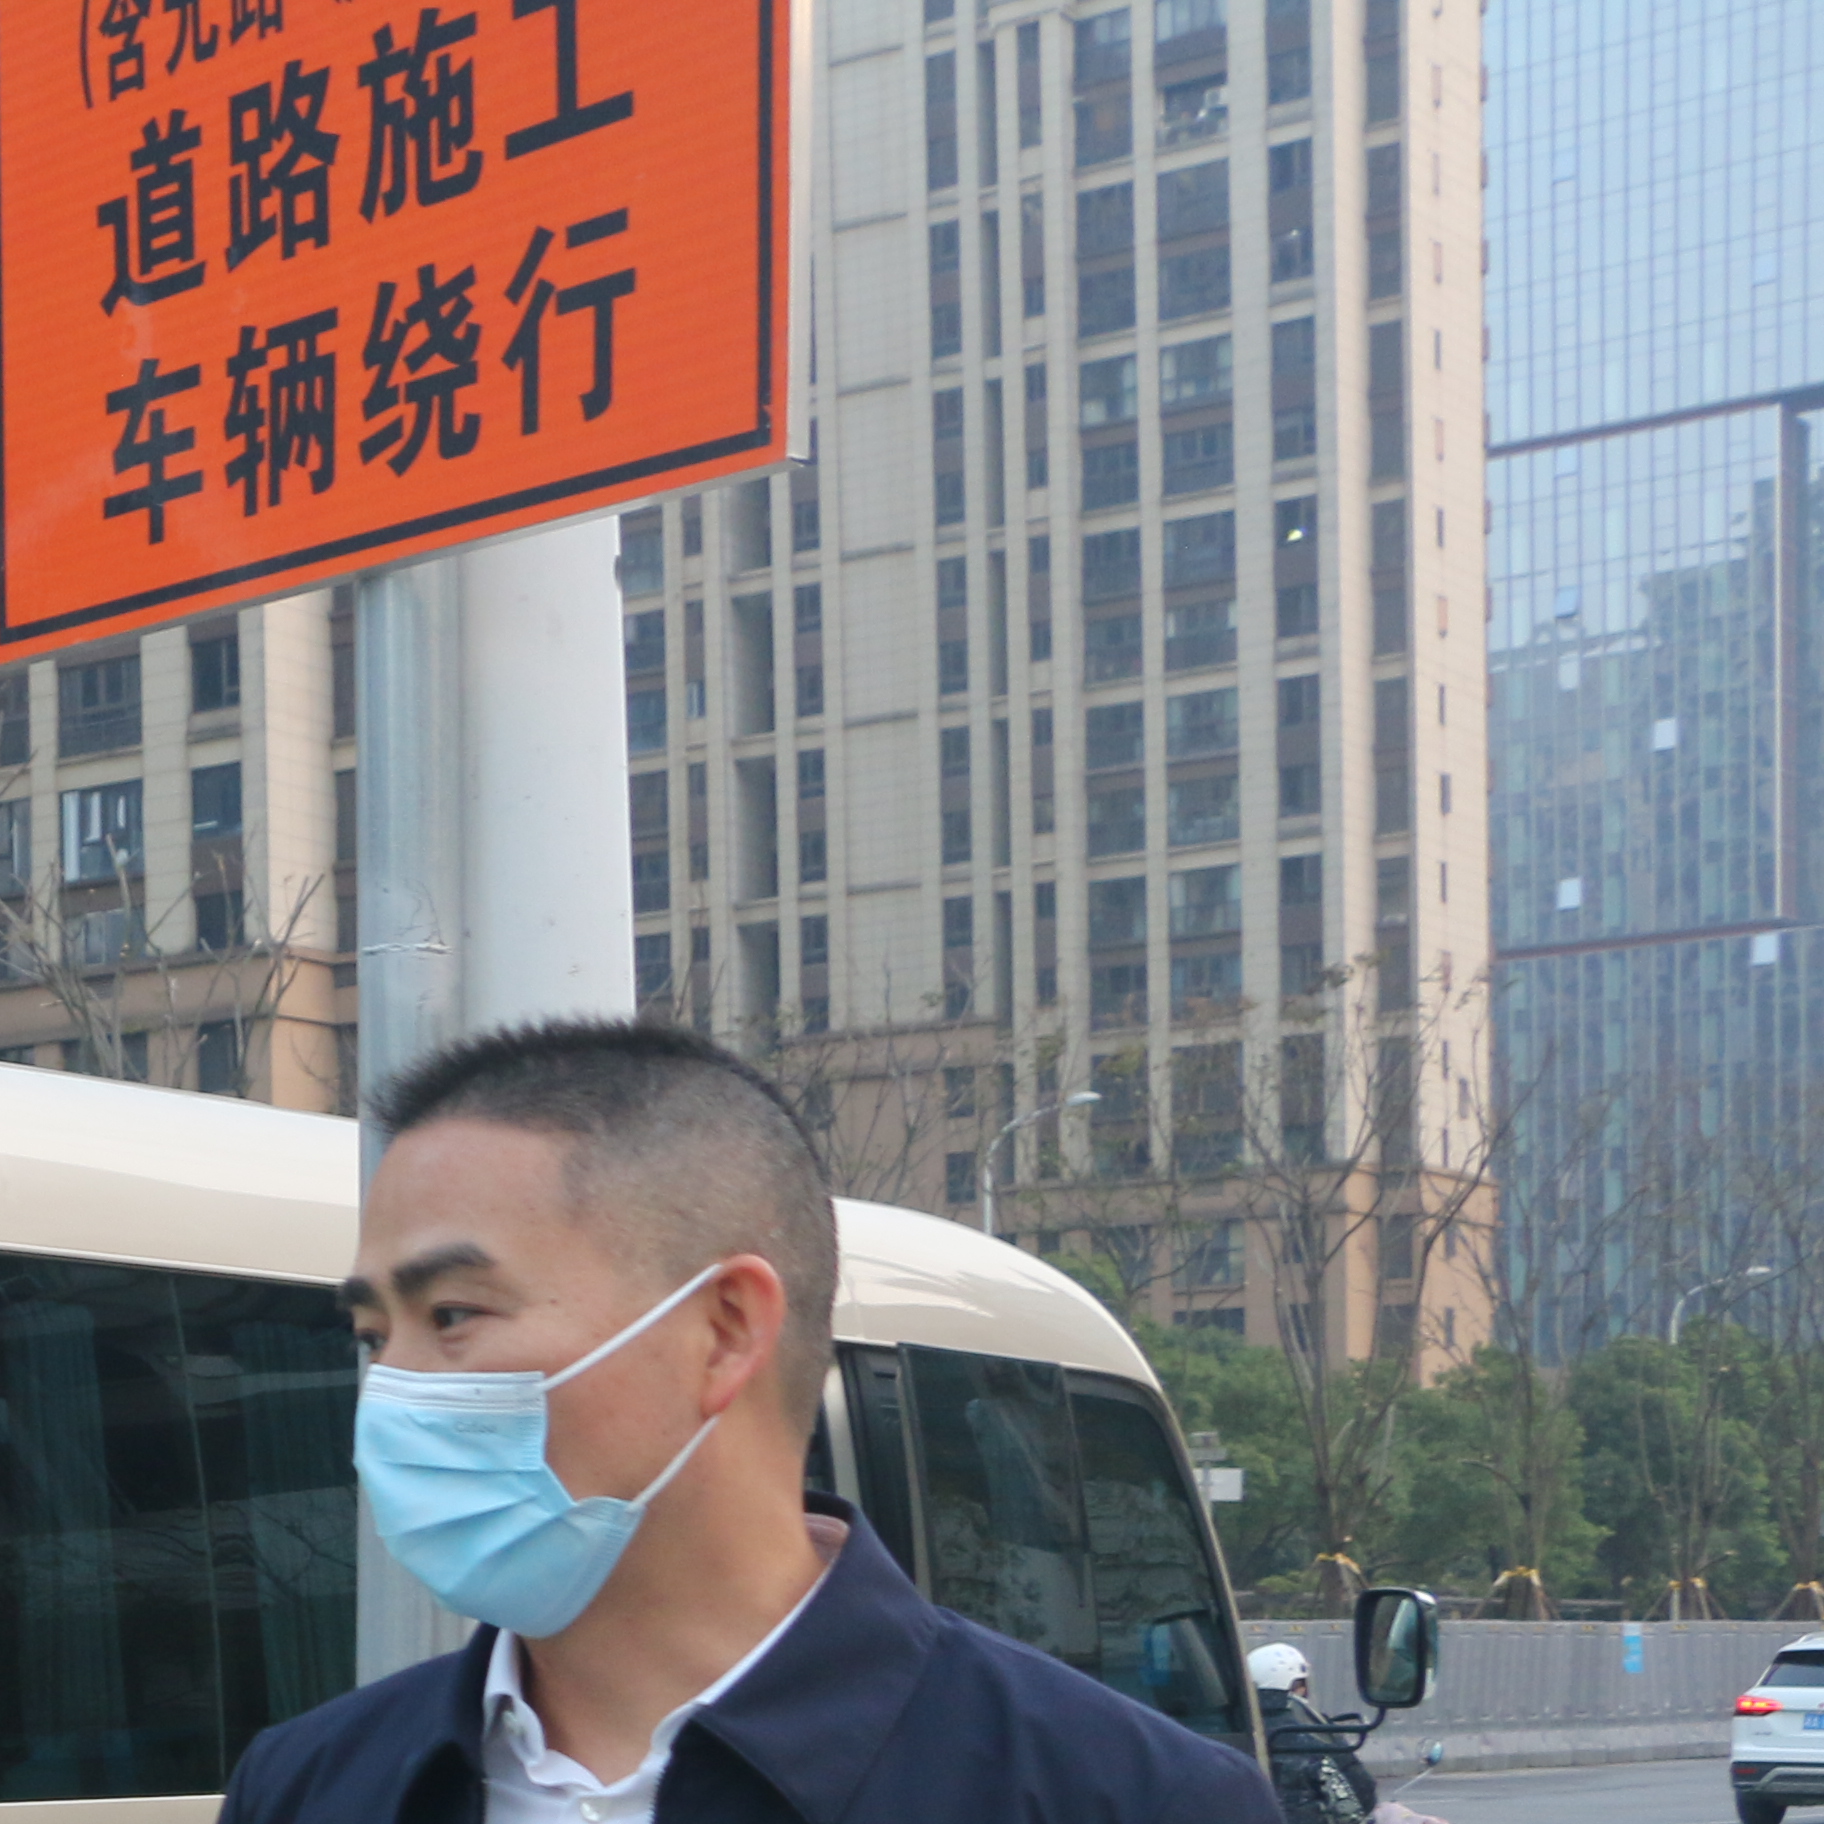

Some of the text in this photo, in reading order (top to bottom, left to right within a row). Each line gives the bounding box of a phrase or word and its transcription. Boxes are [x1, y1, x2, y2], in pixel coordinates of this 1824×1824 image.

[96, 0, 635, 318] 道路施工
[102, 206, 637, 547] 车辆绕行
